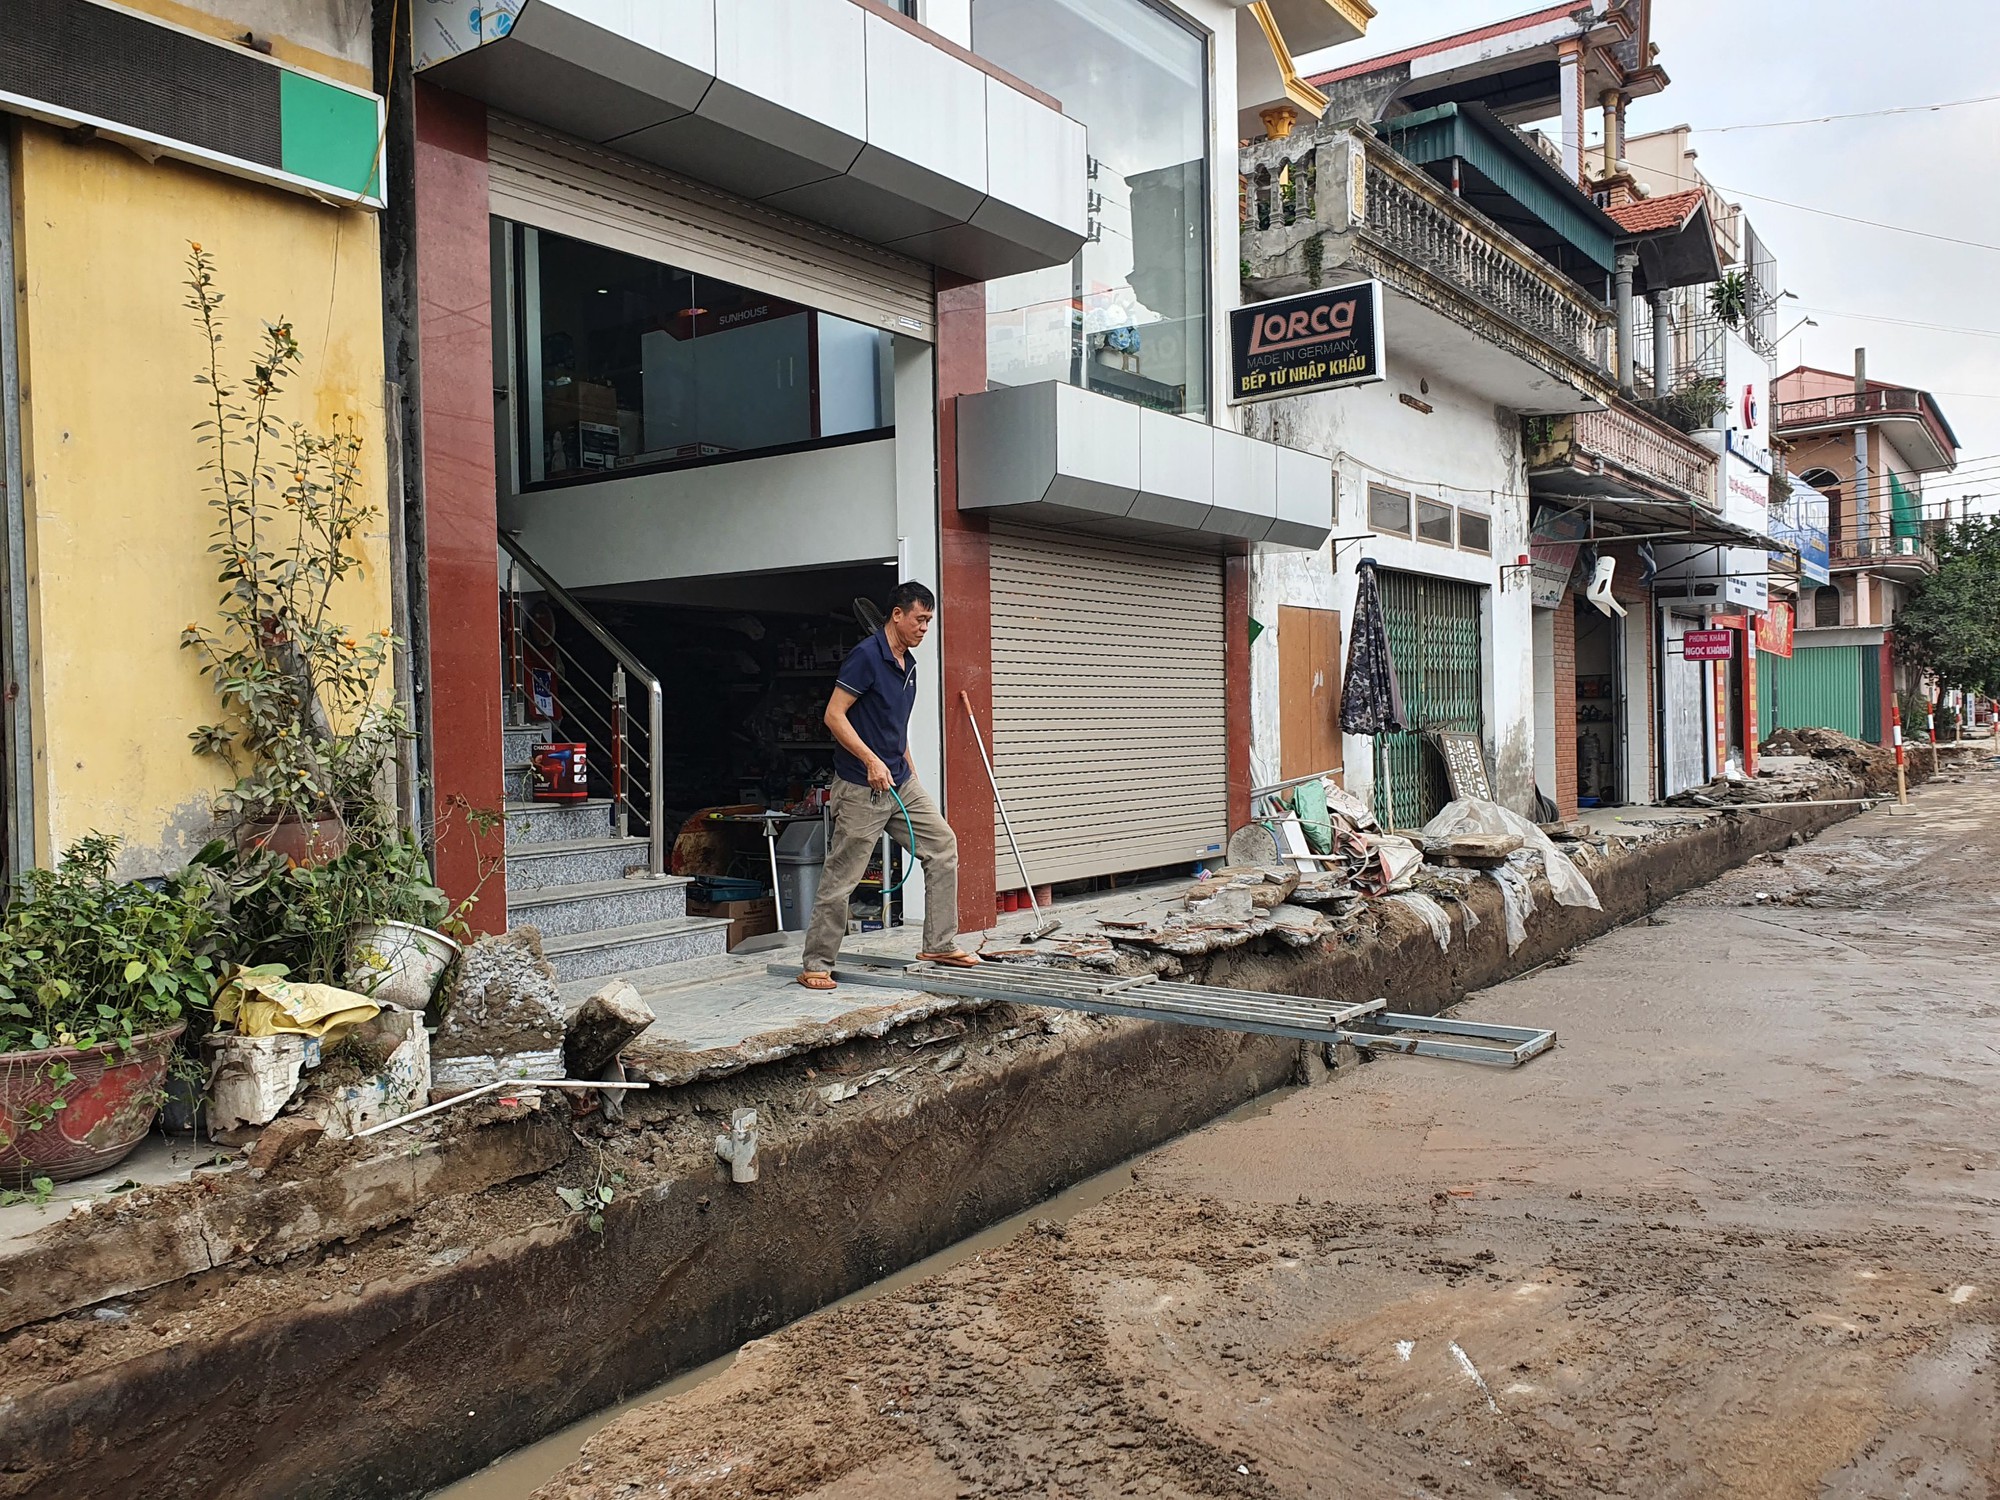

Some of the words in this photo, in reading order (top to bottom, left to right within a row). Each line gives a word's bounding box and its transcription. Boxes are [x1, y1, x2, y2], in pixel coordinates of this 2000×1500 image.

[719, 305, 768, 325] SUNHOUSE
[1247, 352, 1280, 369] MADE
[1283, 349, 1295, 362] IN
[1297, 338, 1359, 360] GERMANY
[1241, 368, 1267, 391] BẾP
[1270, 365, 1287, 386] TỪ
[1289, 360, 1327, 382] NHẬP
[1329, 349, 1366, 376] KHẨU
[1710, 633, 1727, 642] KHÁM
[1685, 646, 1705, 657] NGỌC
[1706, 644, 1730, 655] KHÁNH
